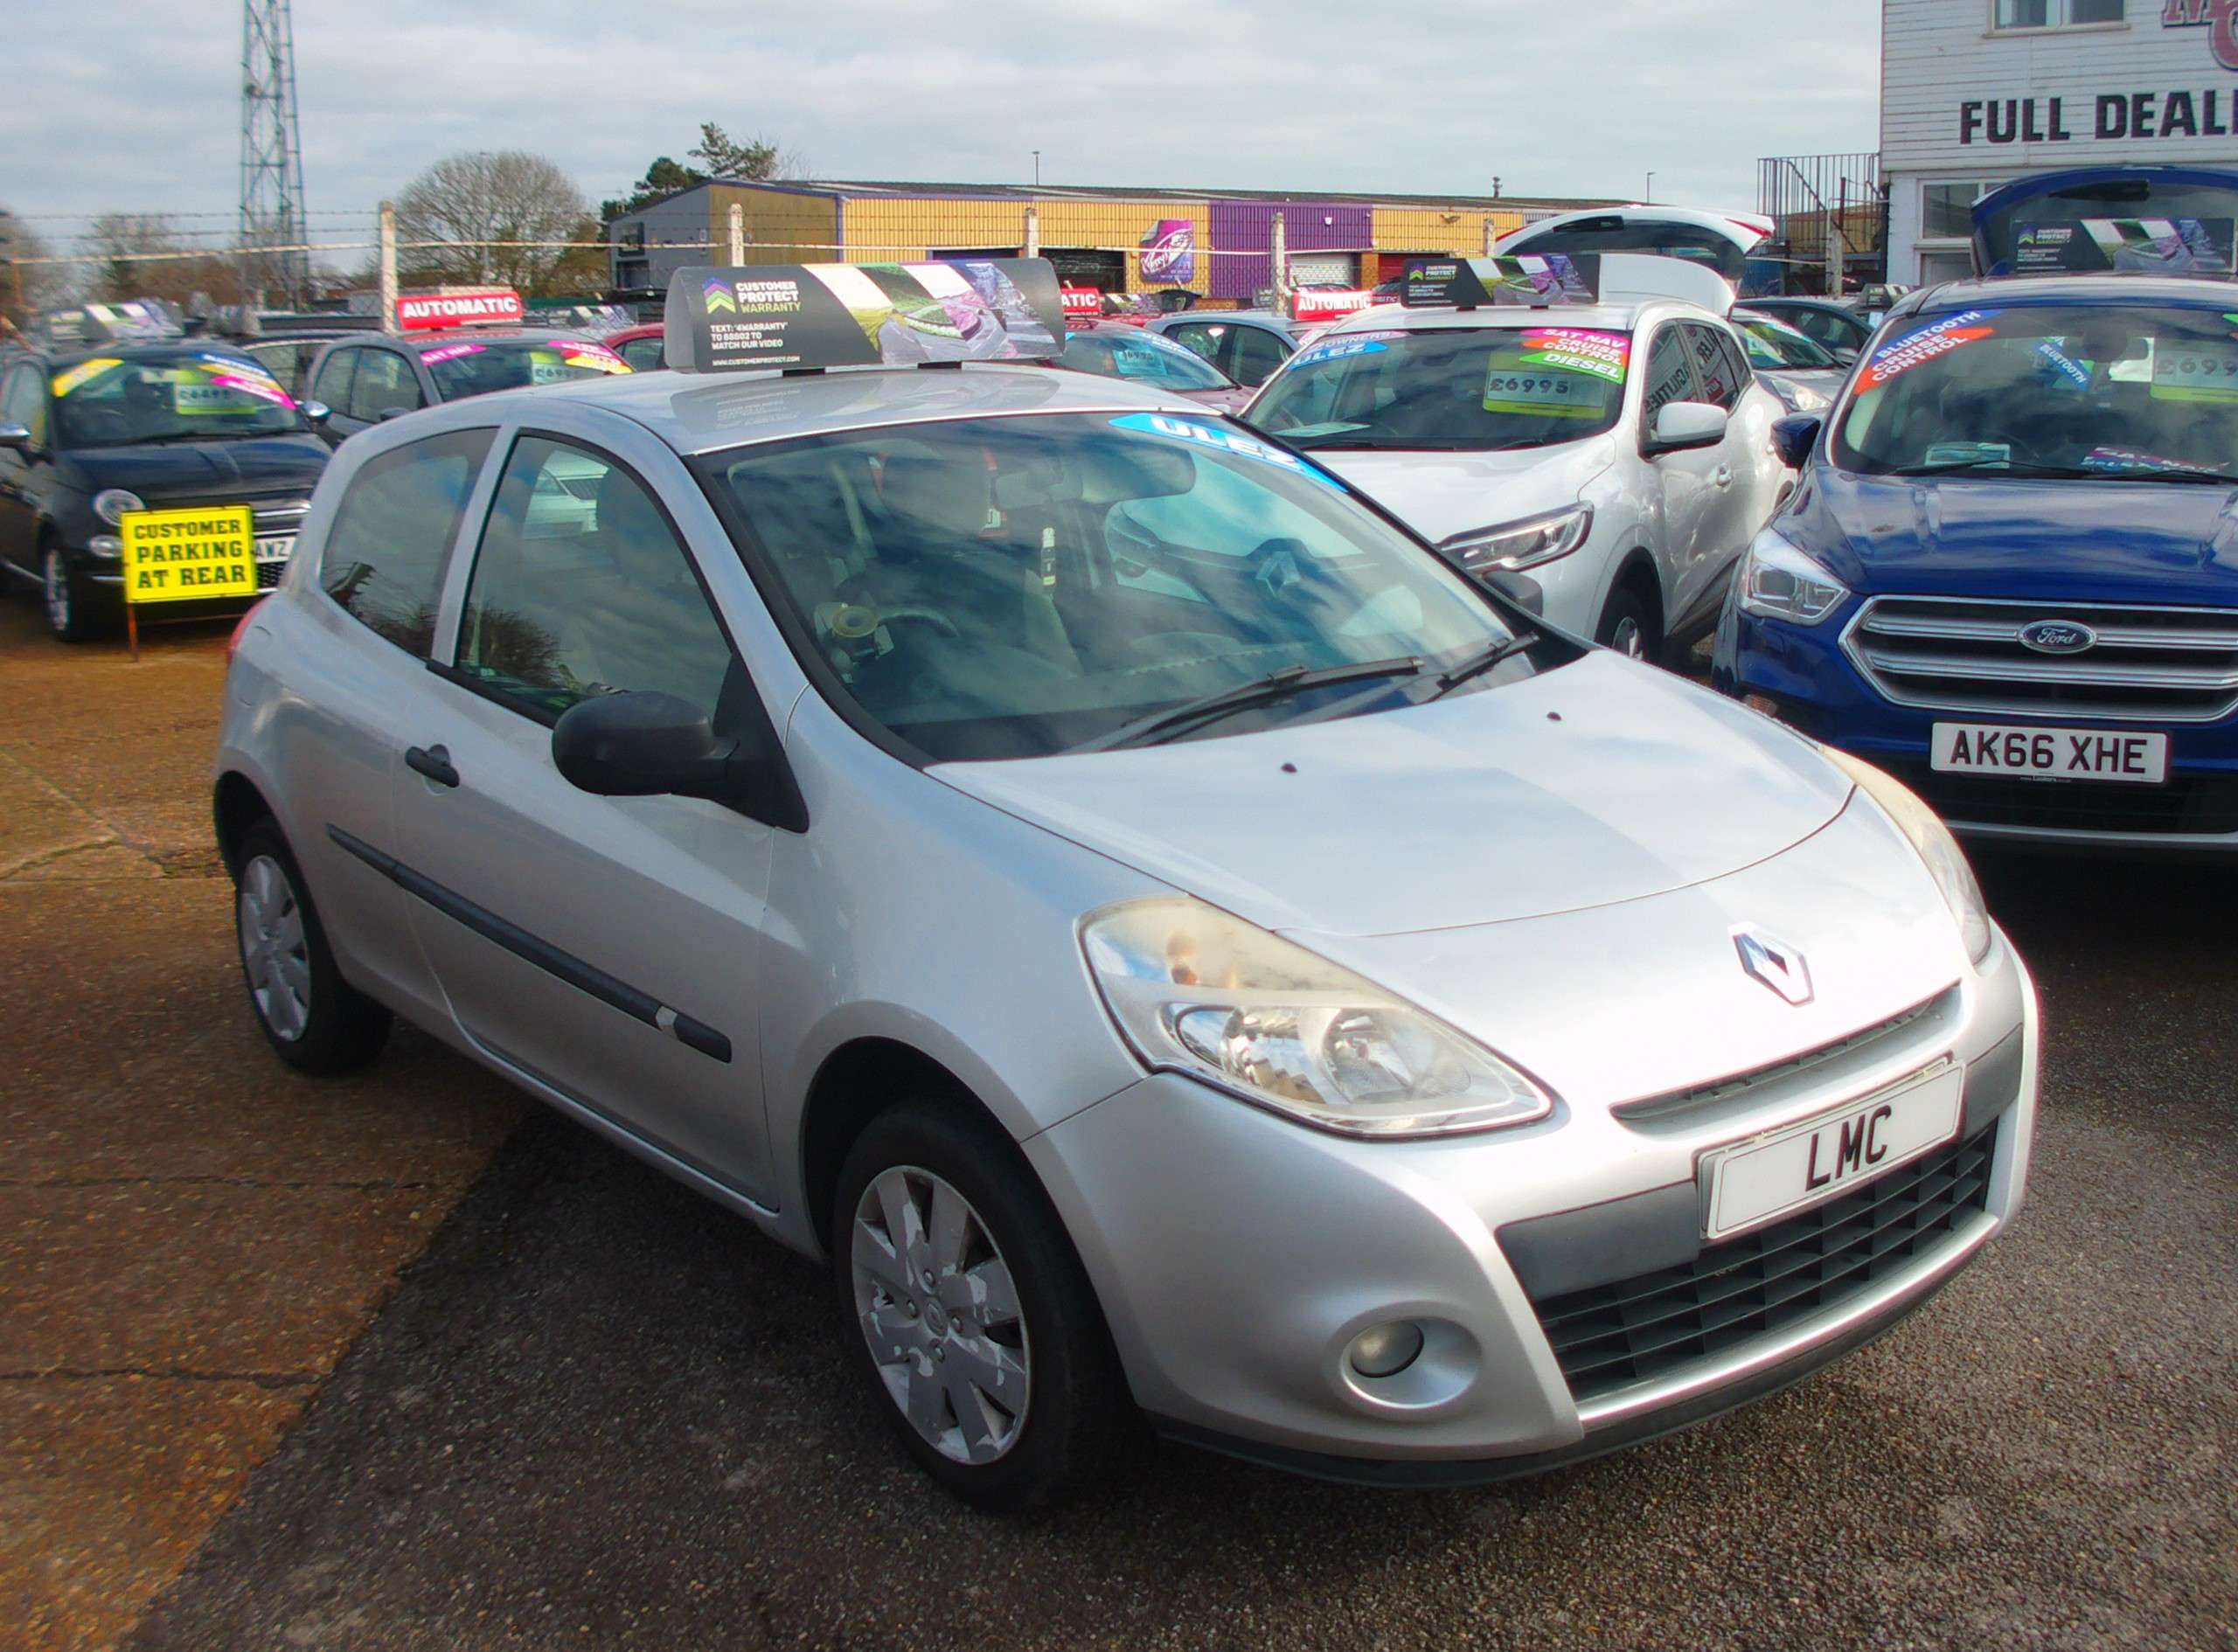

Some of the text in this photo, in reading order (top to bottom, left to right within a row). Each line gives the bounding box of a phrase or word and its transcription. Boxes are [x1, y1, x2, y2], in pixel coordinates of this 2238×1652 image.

[1959, 88, 2238, 145] FULL DEAL
[735, 281, 797, 292] CUSTOMER
[738, 290, 799, 303] PROTECT
[402, 296, 518, 318] AUTOMATIC
[740, 302, 802, 314] WARRANTY
[1298, 295, 1371, 311] AUTOMATIC
[711, 333, 722, 342] TO
[712, 339, 783, 350] WATCH OUR VIDEO
[1542, 329, 1626, 348] SAT NAV
[1876, 311, 1982, 358] BLUETOOTH
[1293, 344, 1366, 365] ULEZ
[1542, 342, 1622, 366] CONTROL
[1558, 337, 1623, 357] CRUISE
[1873, 334, 1949, 372] CRUISE
[1543, 353, 1619, 378] DIESEL
[1872, 337, 1969, 382] CONTROL
[2039, 343, 2087, 385] BLUETOOTH
[1489, 377, 1568, 394] £6995
[1150, 415, 1304, 471] ULEZ
[134, 519, 241, 540] CUSTOMER
[136, 540, 243, 563] PARKING
[137, 564, 246, 589] AT REAR
[2037, 627, 2077, 645] Ford
[1950, 729, 2148, 774] AK66 XHE
[1805, 1104, 1892, 1192] LMC
